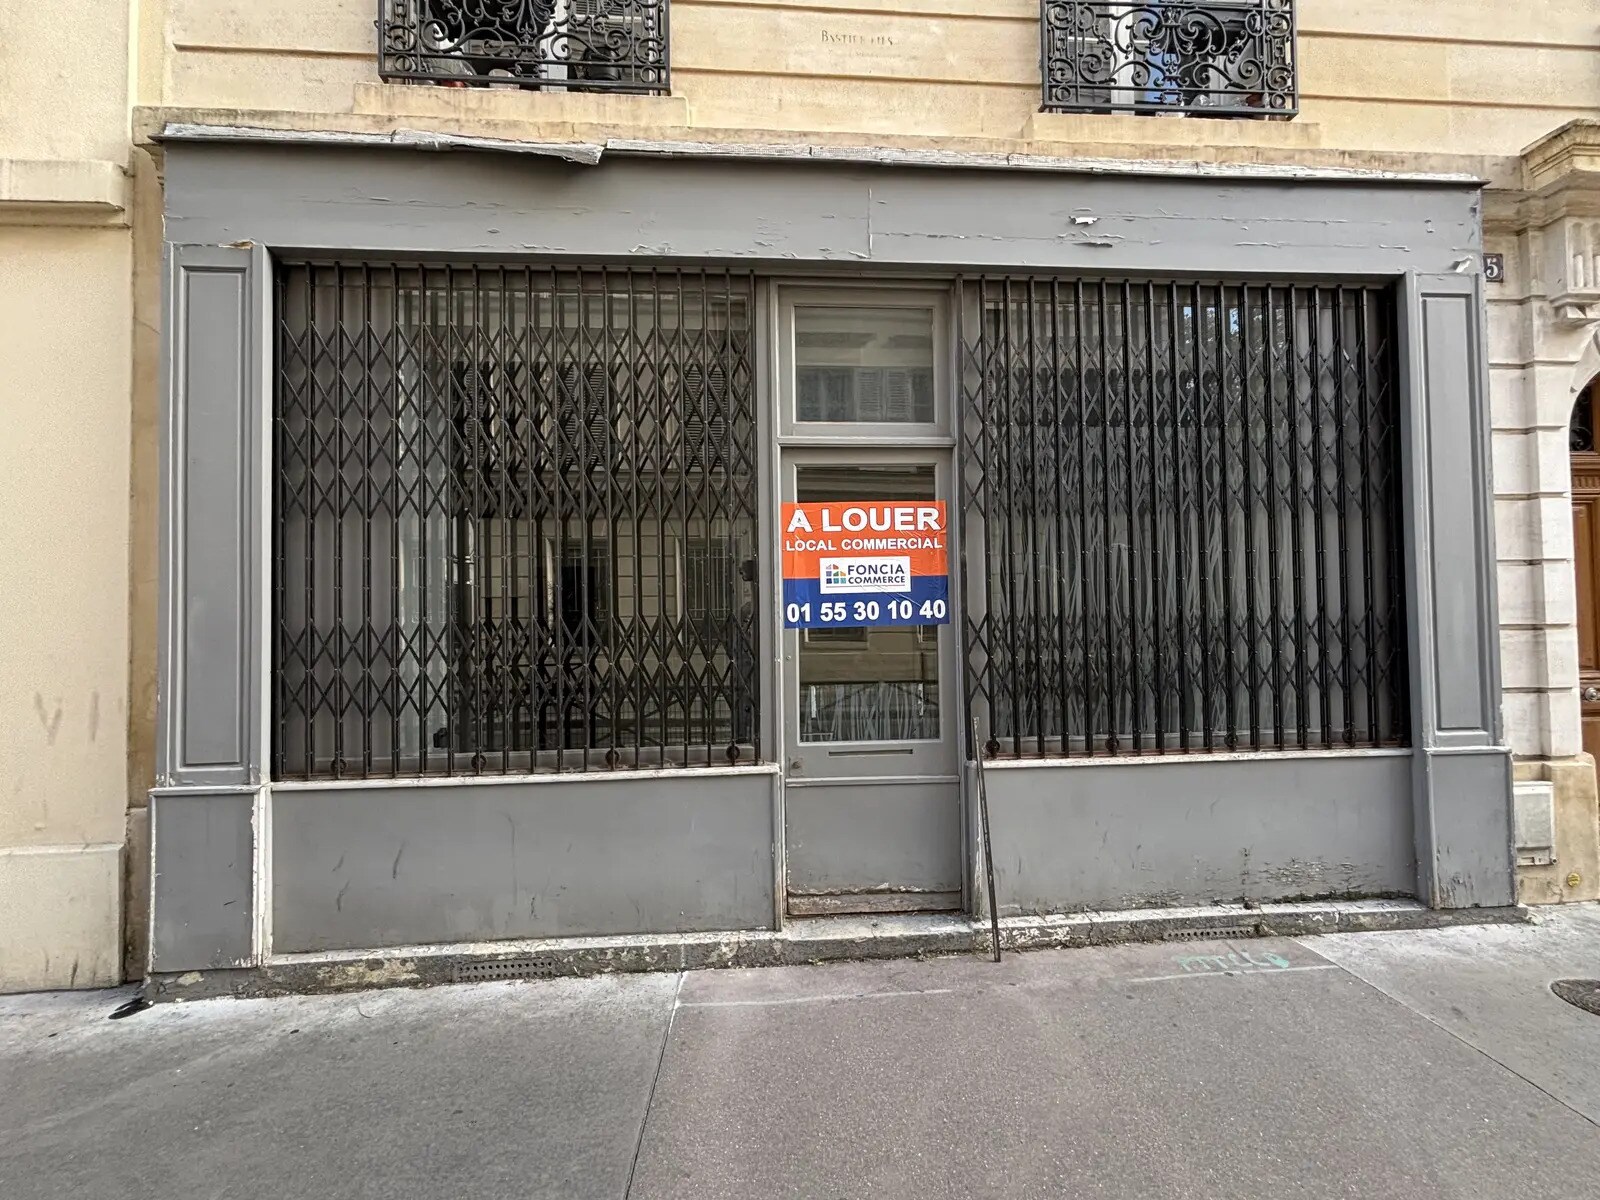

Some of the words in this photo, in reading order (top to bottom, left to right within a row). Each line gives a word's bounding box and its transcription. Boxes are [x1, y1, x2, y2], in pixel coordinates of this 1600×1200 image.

[786, 508, 814, 533] A
[821, 507, 942, 533] LOUER
[785, 539, 837, 551] LOCAL
[841, 537, 943, 551] COMMERCIAL
[848, 563, 905, 576] FONCIA
[848, 575, 906, 585] COMMERCE
[786, 602, 811, 623] 01
[820, 602, 847, 622] 55
[853, 600, 880, 621] 30
[887, 600, 913, 620] 10
[919, 599, 946, 619] 40
